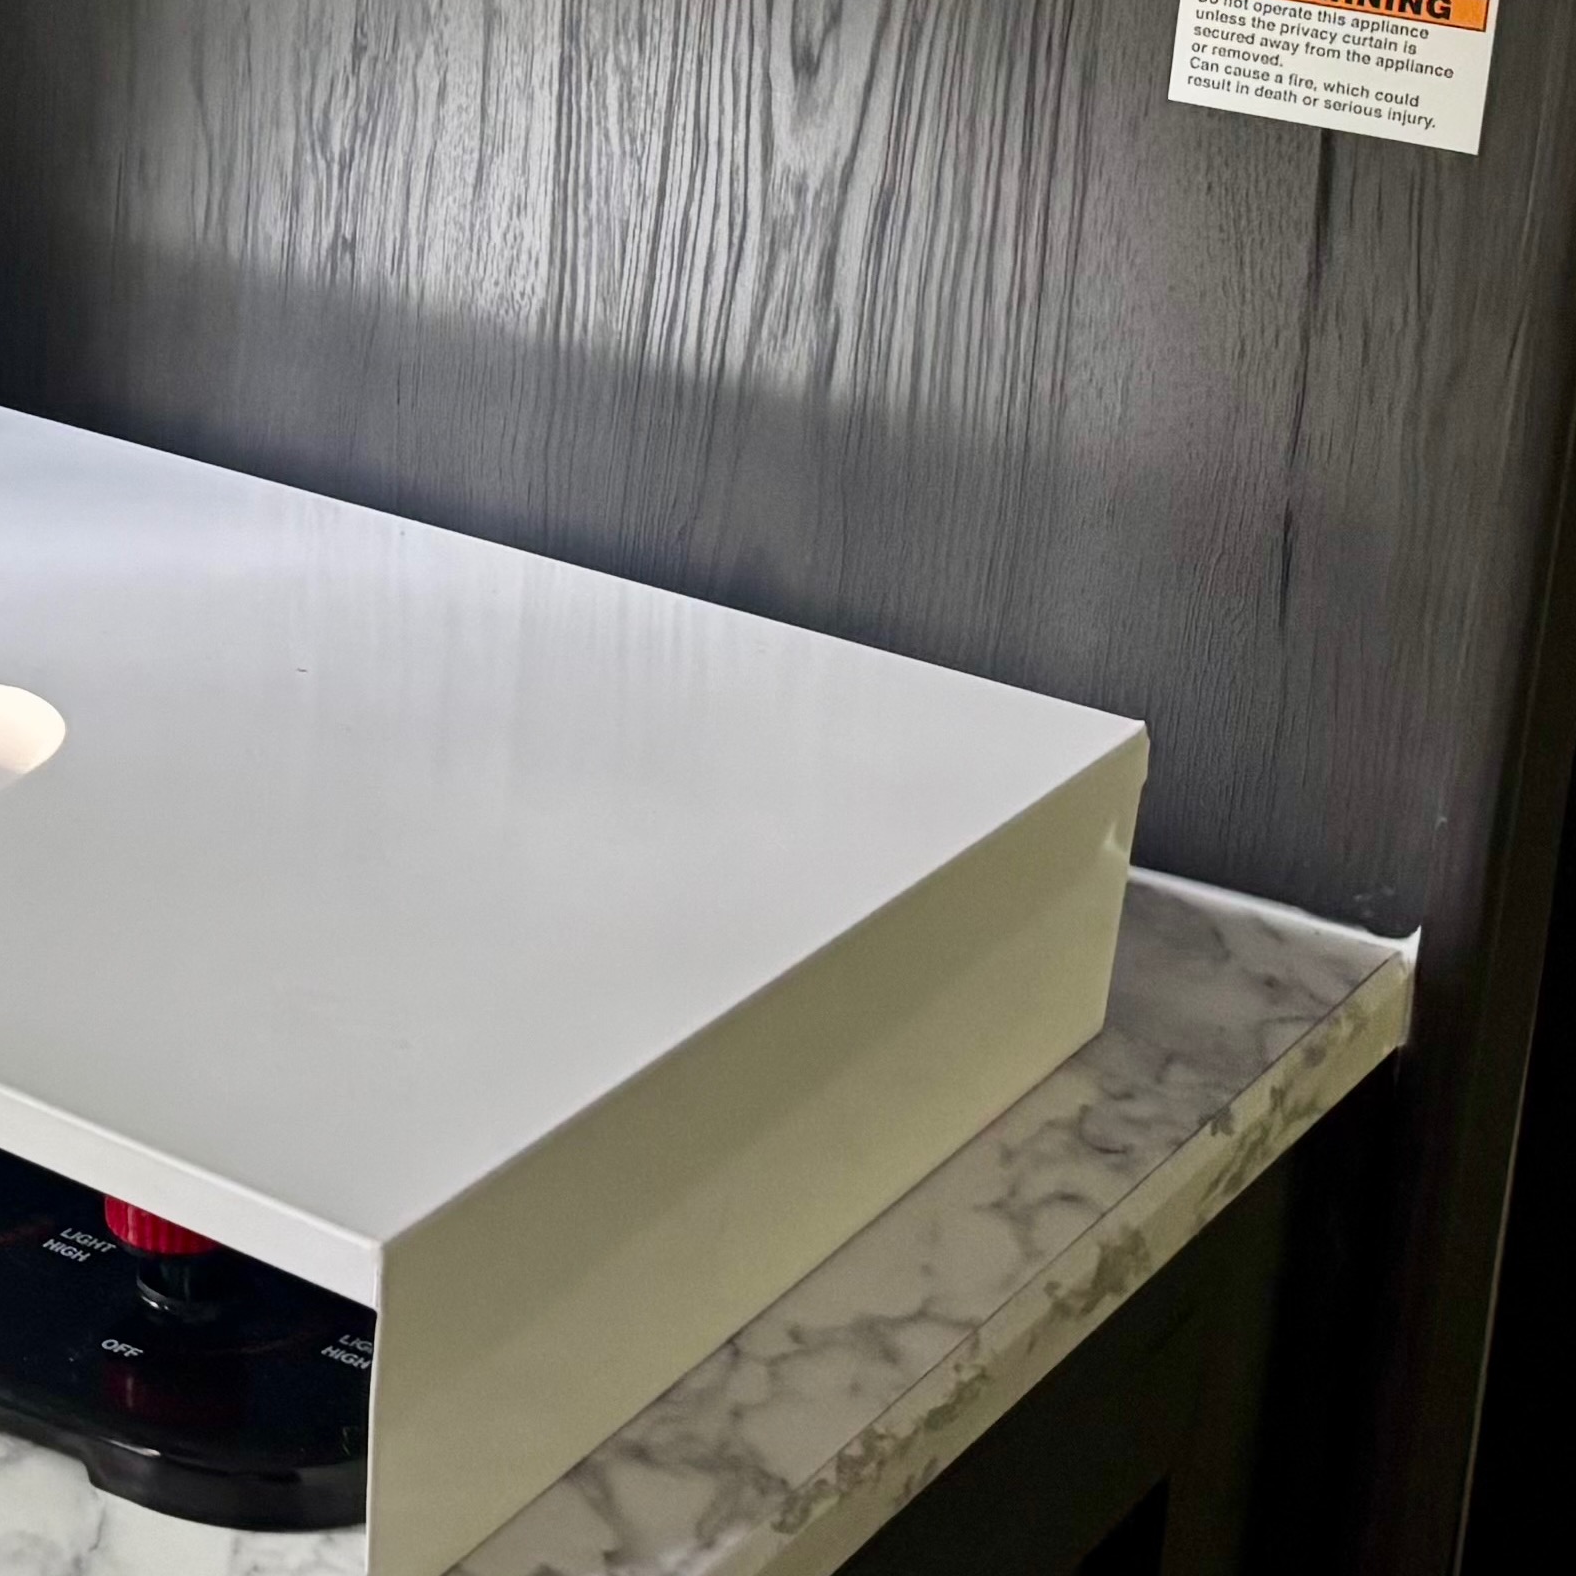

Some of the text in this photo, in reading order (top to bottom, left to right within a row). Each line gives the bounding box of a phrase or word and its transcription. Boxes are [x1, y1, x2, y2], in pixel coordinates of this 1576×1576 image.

[1195, 9, 1416, 55] unless the privacy curtain is
[1252, 1, 1312, 20] operate
[1317, 10, 1345, 26] this
[1350, 17, 1429, 39] appliance
[1189, 56, 1219, 72] Can
[1223, 65, 1270, 81] cause
[1274, 73, 1282, 83] a
[1323, 81, 1369, 98] which
[1374, 91, 1419, 107] could
[1187, 75, 1231, 92] result
[1235, 80, 1249, 94] in
[1254, 85, 1297, 103] death
[1301, 95, 1319, 106] or
[1323, 98, 1382, 118] serious
[42, 1238, 92, 1263] HIGH
[59, 1227, 116, 1254] LIGHT
[101, 1339, 144, 1359] OFF
[320, 1345, 371, 1370] HIGH
[338, 1334, 373, 1354] LIG
